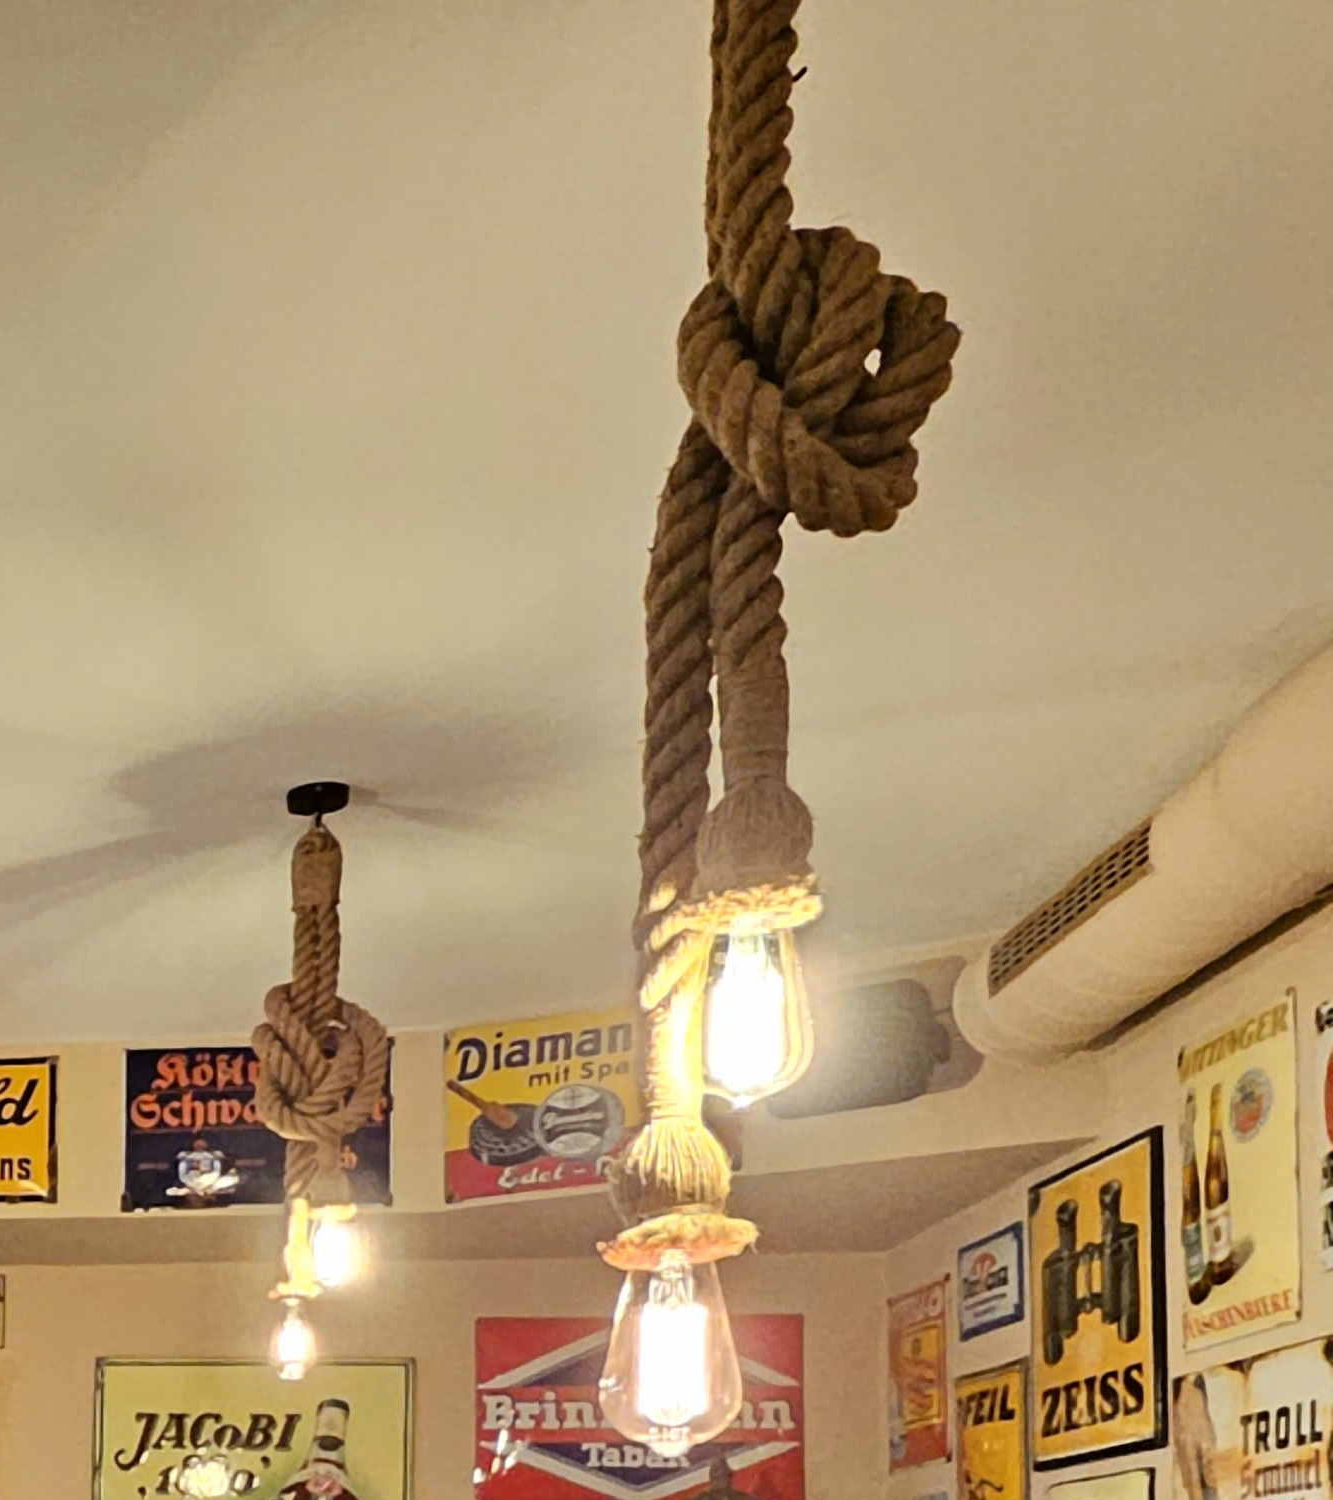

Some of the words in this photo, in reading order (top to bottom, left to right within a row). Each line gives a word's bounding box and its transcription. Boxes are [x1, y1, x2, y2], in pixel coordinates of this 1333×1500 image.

[456, 1023, 632, 1082] Diaman
[529, 1066, 570, 1088] mit
[580, 1061, 630, 1082] Spa
[1041, 1362, 1144, 1438] ZEISS
[1240, 1400, 1323, 1457] TROLL
[114, 1412, 302, 1471] JACOBI
